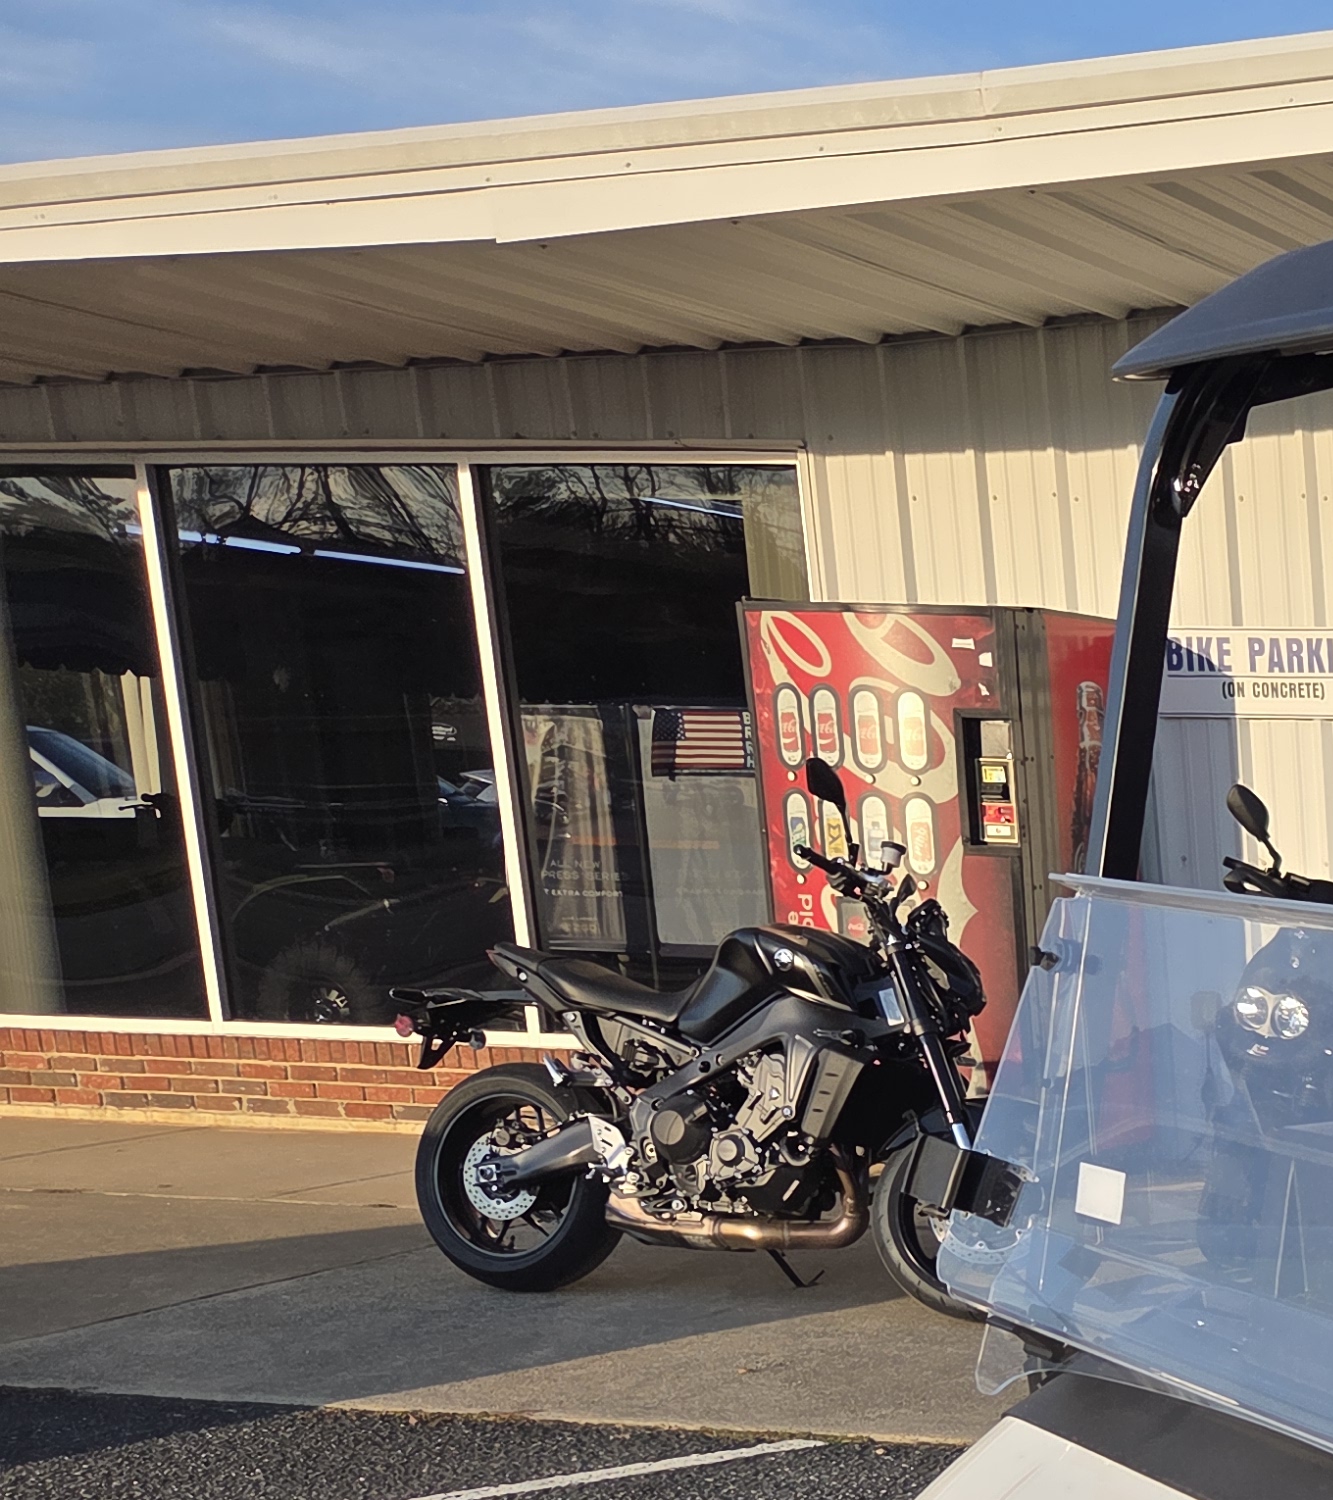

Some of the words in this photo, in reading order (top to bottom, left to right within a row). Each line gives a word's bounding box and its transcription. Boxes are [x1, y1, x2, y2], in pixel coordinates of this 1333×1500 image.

[1166, 635, 1232, 673] BIKE
[1222, 680, 1246, 699] (ON
[1252, 681, 1326, 700] CONCRETE)
